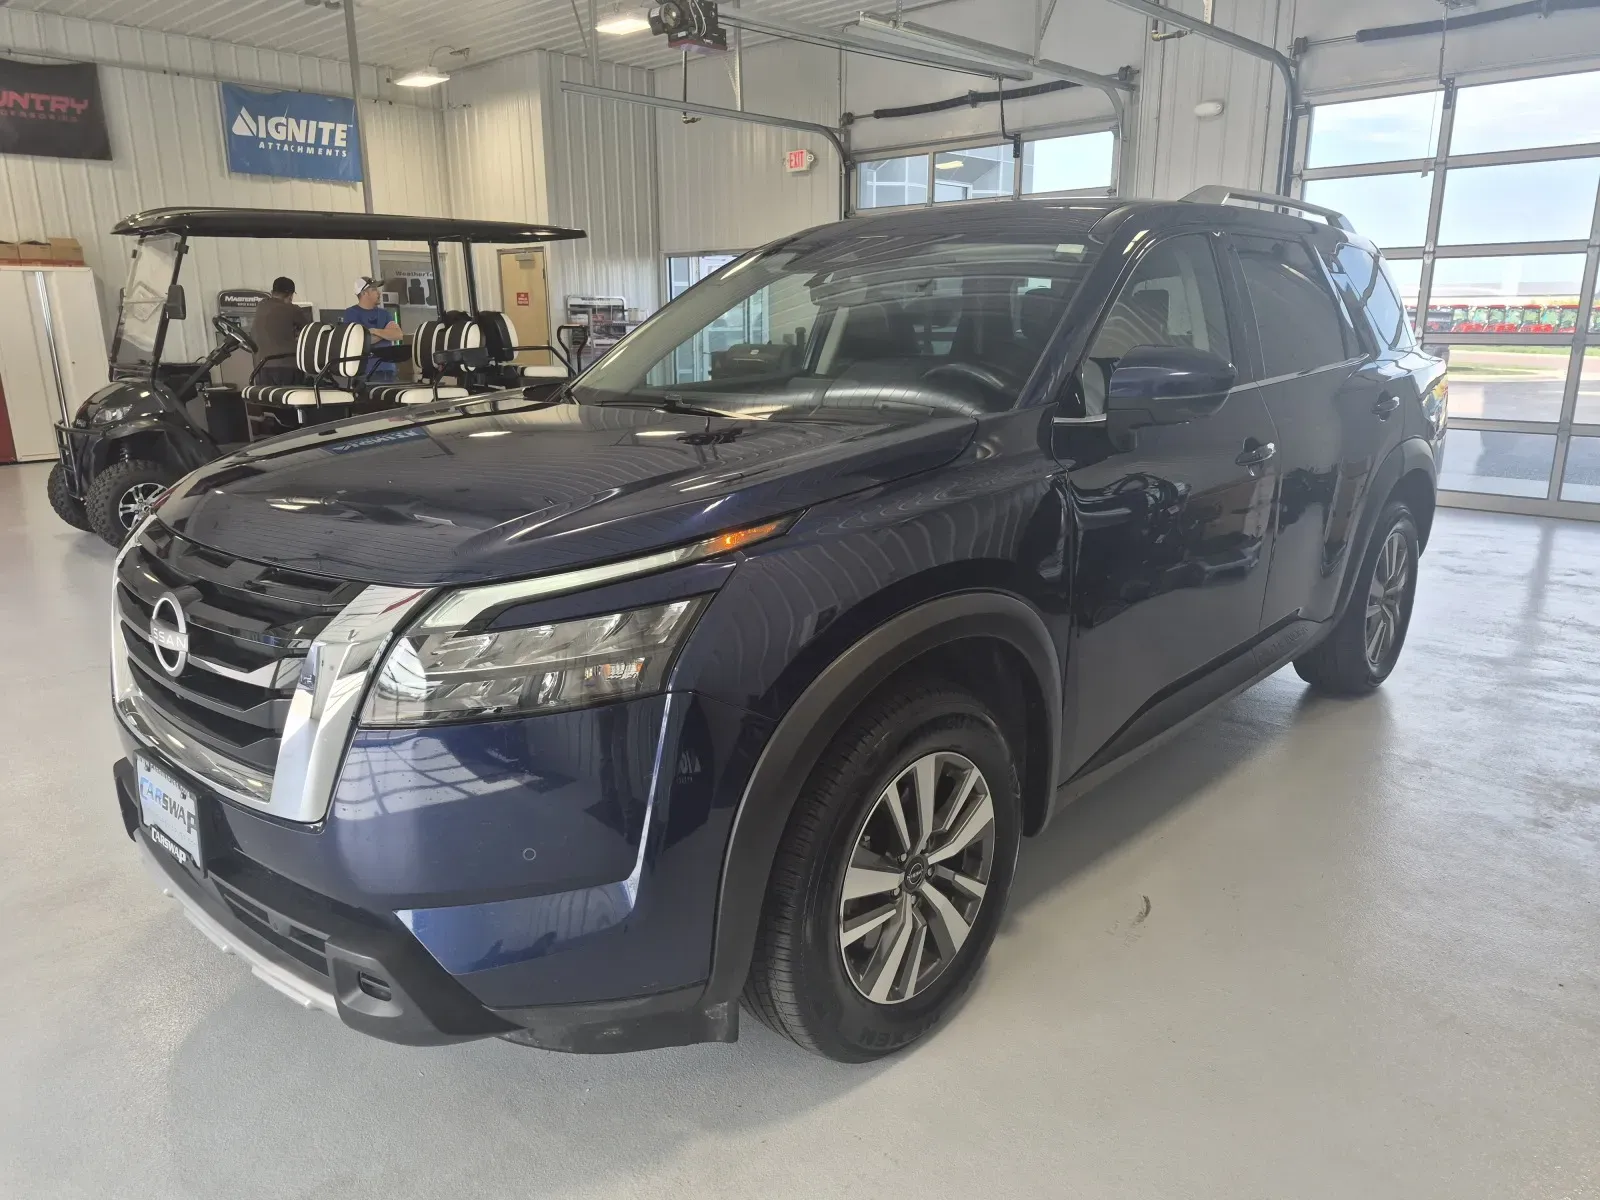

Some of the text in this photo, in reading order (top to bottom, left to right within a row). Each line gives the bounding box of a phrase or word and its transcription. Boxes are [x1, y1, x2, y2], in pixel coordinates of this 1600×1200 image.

[257, 115, 348, 147] IGNITE
[258, 141, 347, 158] ATTACHMENTS
[789, 151, 804, 169] EXIT
[153, 627, 187, 650] SSAN
[140, 776, 199, 835] CARSWAP
[151, 826, 187, 864] CARSWAP
